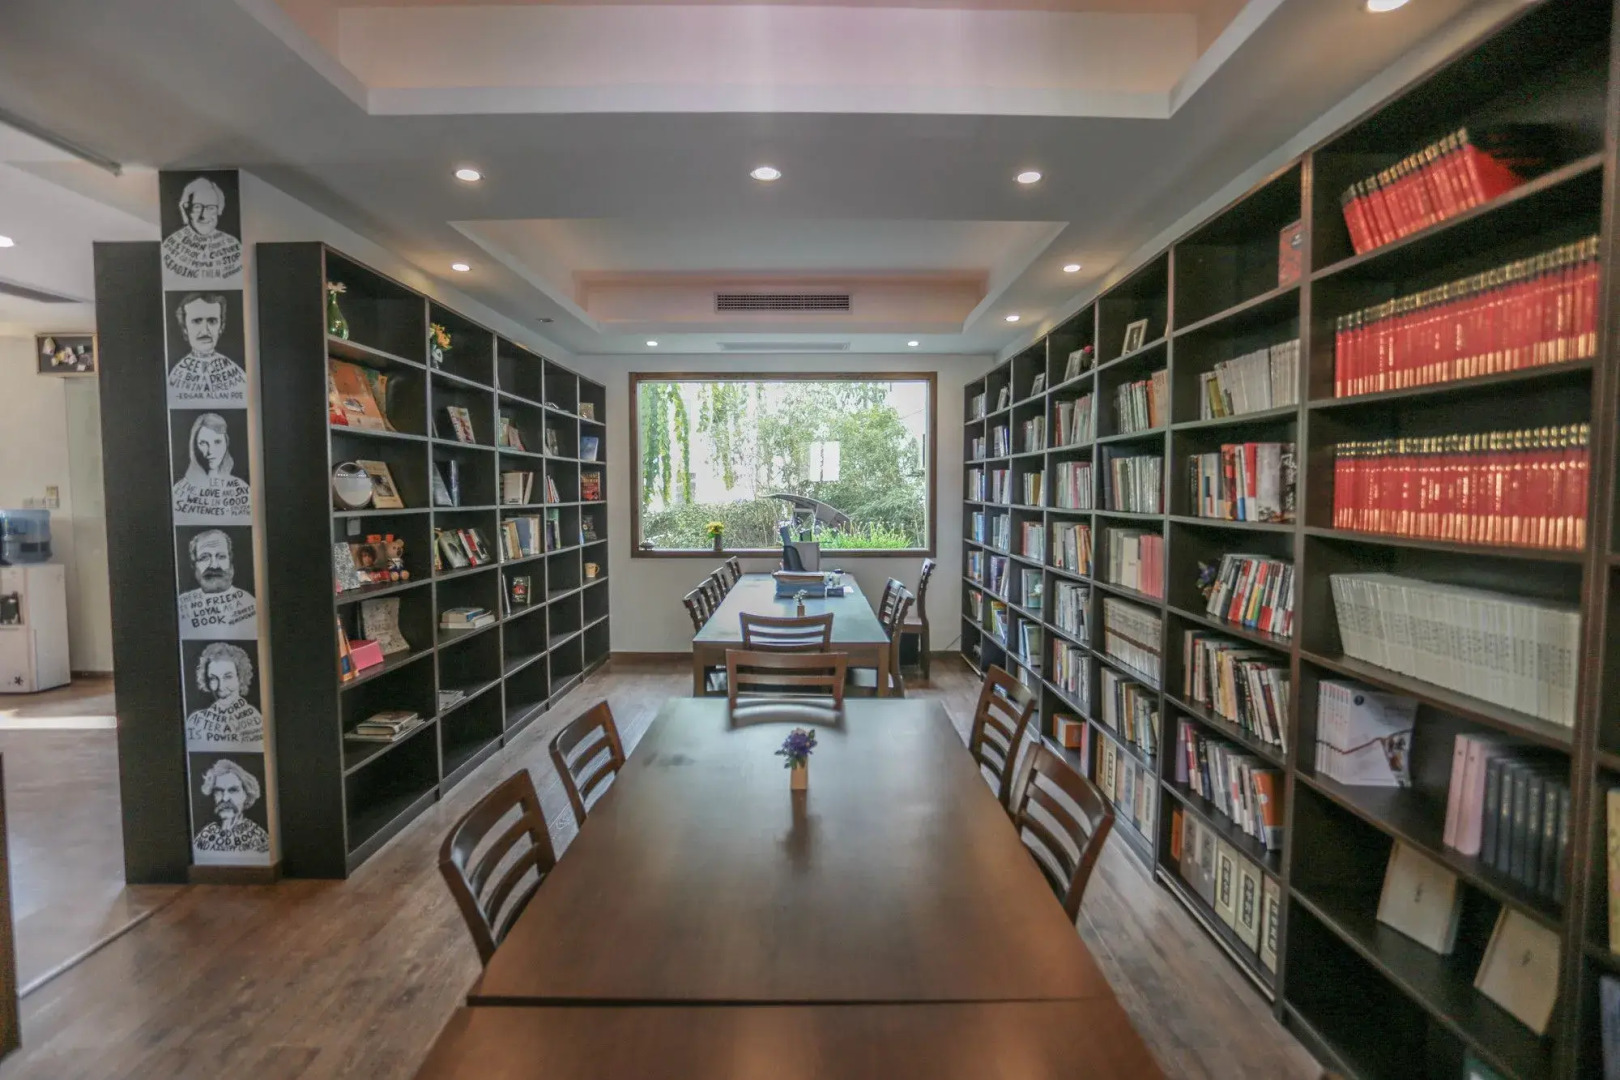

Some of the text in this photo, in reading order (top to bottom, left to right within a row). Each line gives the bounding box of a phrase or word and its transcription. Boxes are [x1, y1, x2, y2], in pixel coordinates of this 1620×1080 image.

[164, 254, 200, 279] READING
[179, 357, 200, 373] SEE
[209, 367, 241, 384] DREAM
[204, 383, 210, 392] A
[226, 479, 240, 487] ME
[199, 488, 221, 498] LOVE
[235, 487, 249, 497] SAY
[174, 500, 225, 515] SENTENCES
[187, 495, 209, 505] WELL
[223, 496, 249, 507] GOOD
[190, 601, 203, 609] NO
[206, 590, 244, 606] FRIEND
[193, 606, 221, 617] LOYAL
[191, 615, 226, 628] BOOK
[218, 698, 245, 714] WORD
[235, 707, 254, 720] WORD
[188, 727, 202, 740] IS
[223, 724, 232, 733] A
